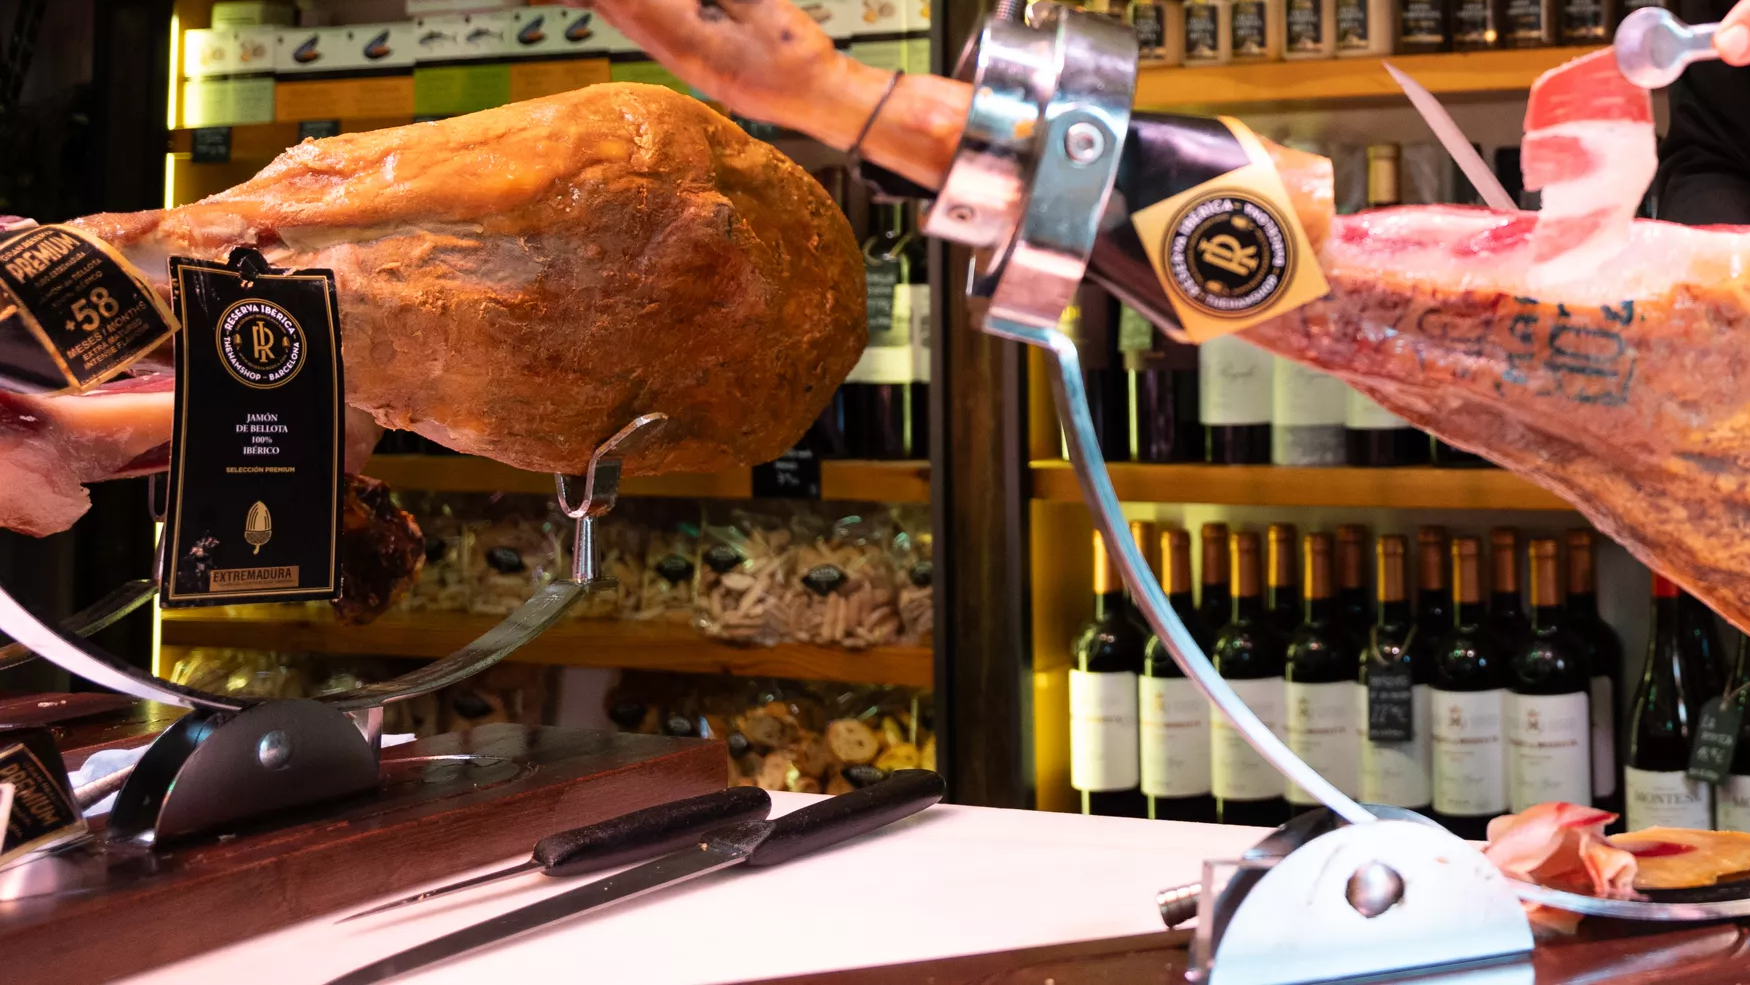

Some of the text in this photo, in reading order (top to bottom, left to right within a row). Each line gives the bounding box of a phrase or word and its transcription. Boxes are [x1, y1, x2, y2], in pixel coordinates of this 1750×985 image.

[5, 233, 81, 284] PREMIUM
[65, 287, 119, 332] +58
[224, 304, 260, 331] RESERVA
[67, 332, 103, 360] MESES
[107, 302, 147, 332] MONTHS
[269, 342, 299, 381] BARCELONA
[246, 412, 278, 423] JAMÓN
[235, 425, 288, 433] DE BELLOTA
[243, 445, 280, 455] IBÉRICO
[251, 436, 273, 444] 100%
[213, 568, 292, 583] EXTREMADURA
